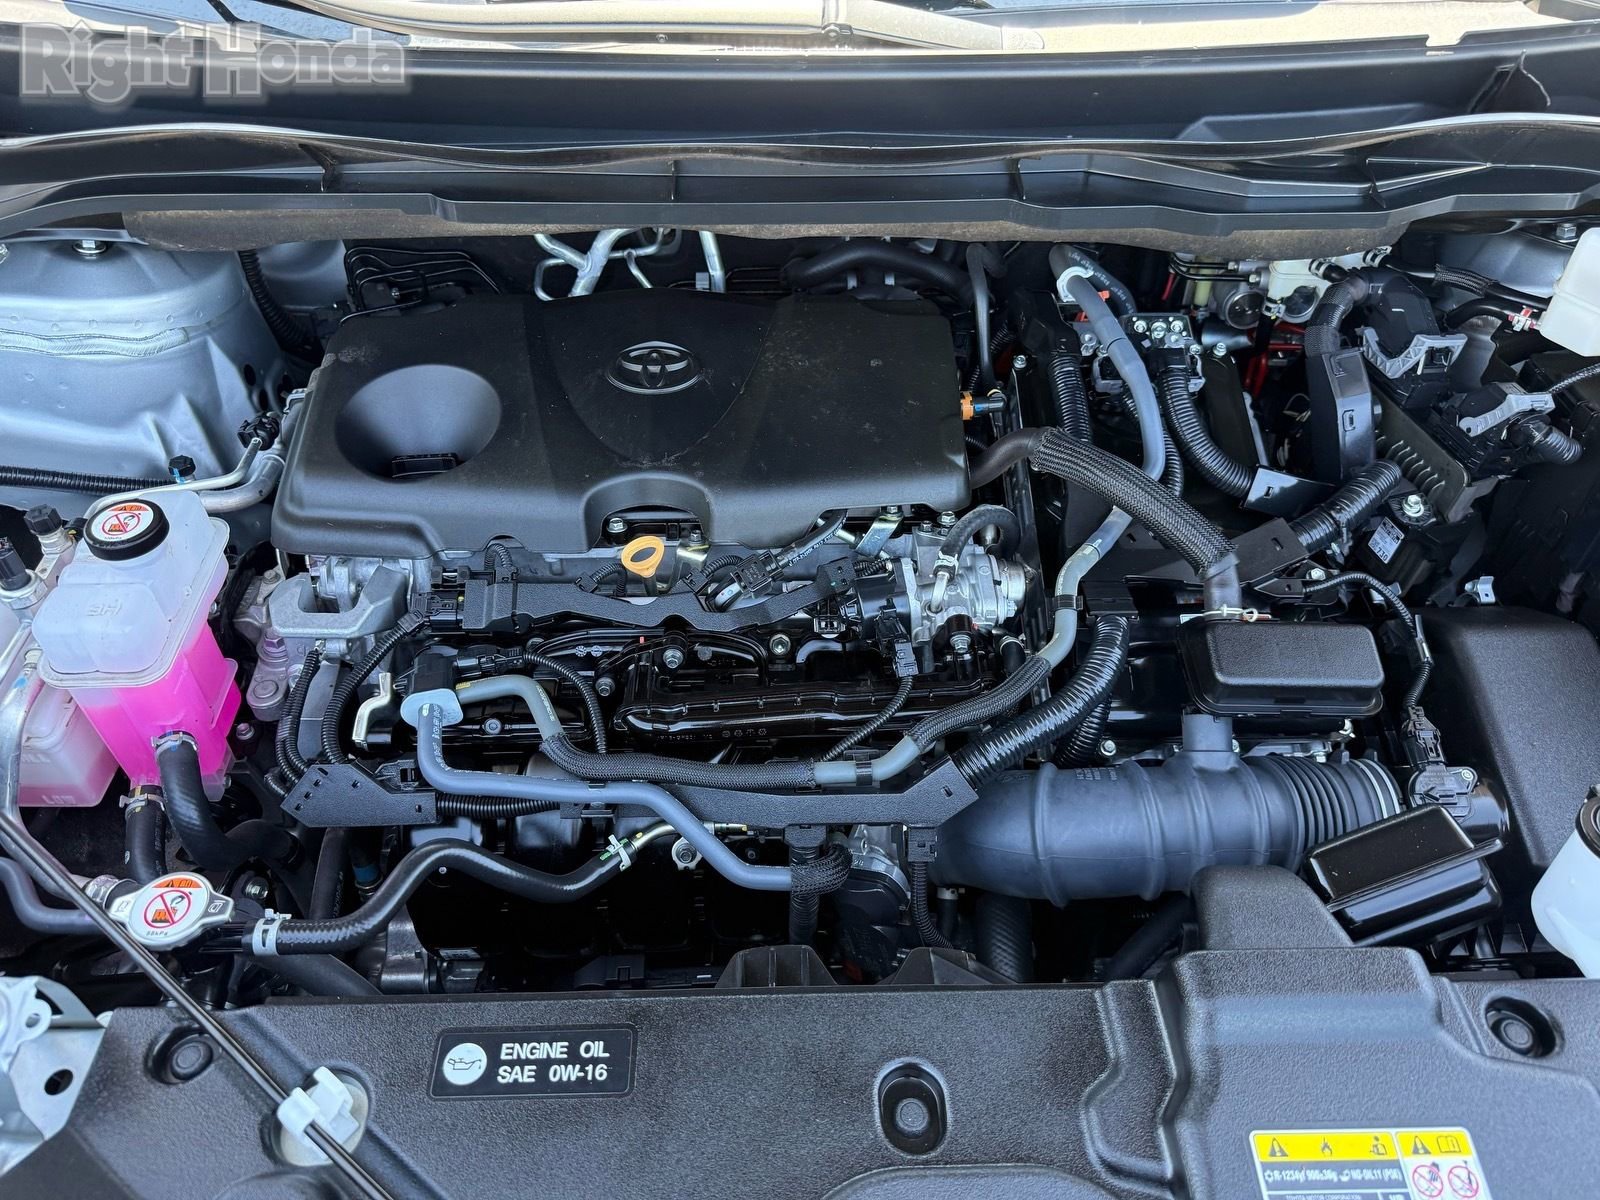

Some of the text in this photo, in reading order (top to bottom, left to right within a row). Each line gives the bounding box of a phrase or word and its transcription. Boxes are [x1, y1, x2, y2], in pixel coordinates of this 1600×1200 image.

[500, 1040, 610, 1060] ENGINE OIL
[496, 1064, 608, 1084] SAE 0W-16
